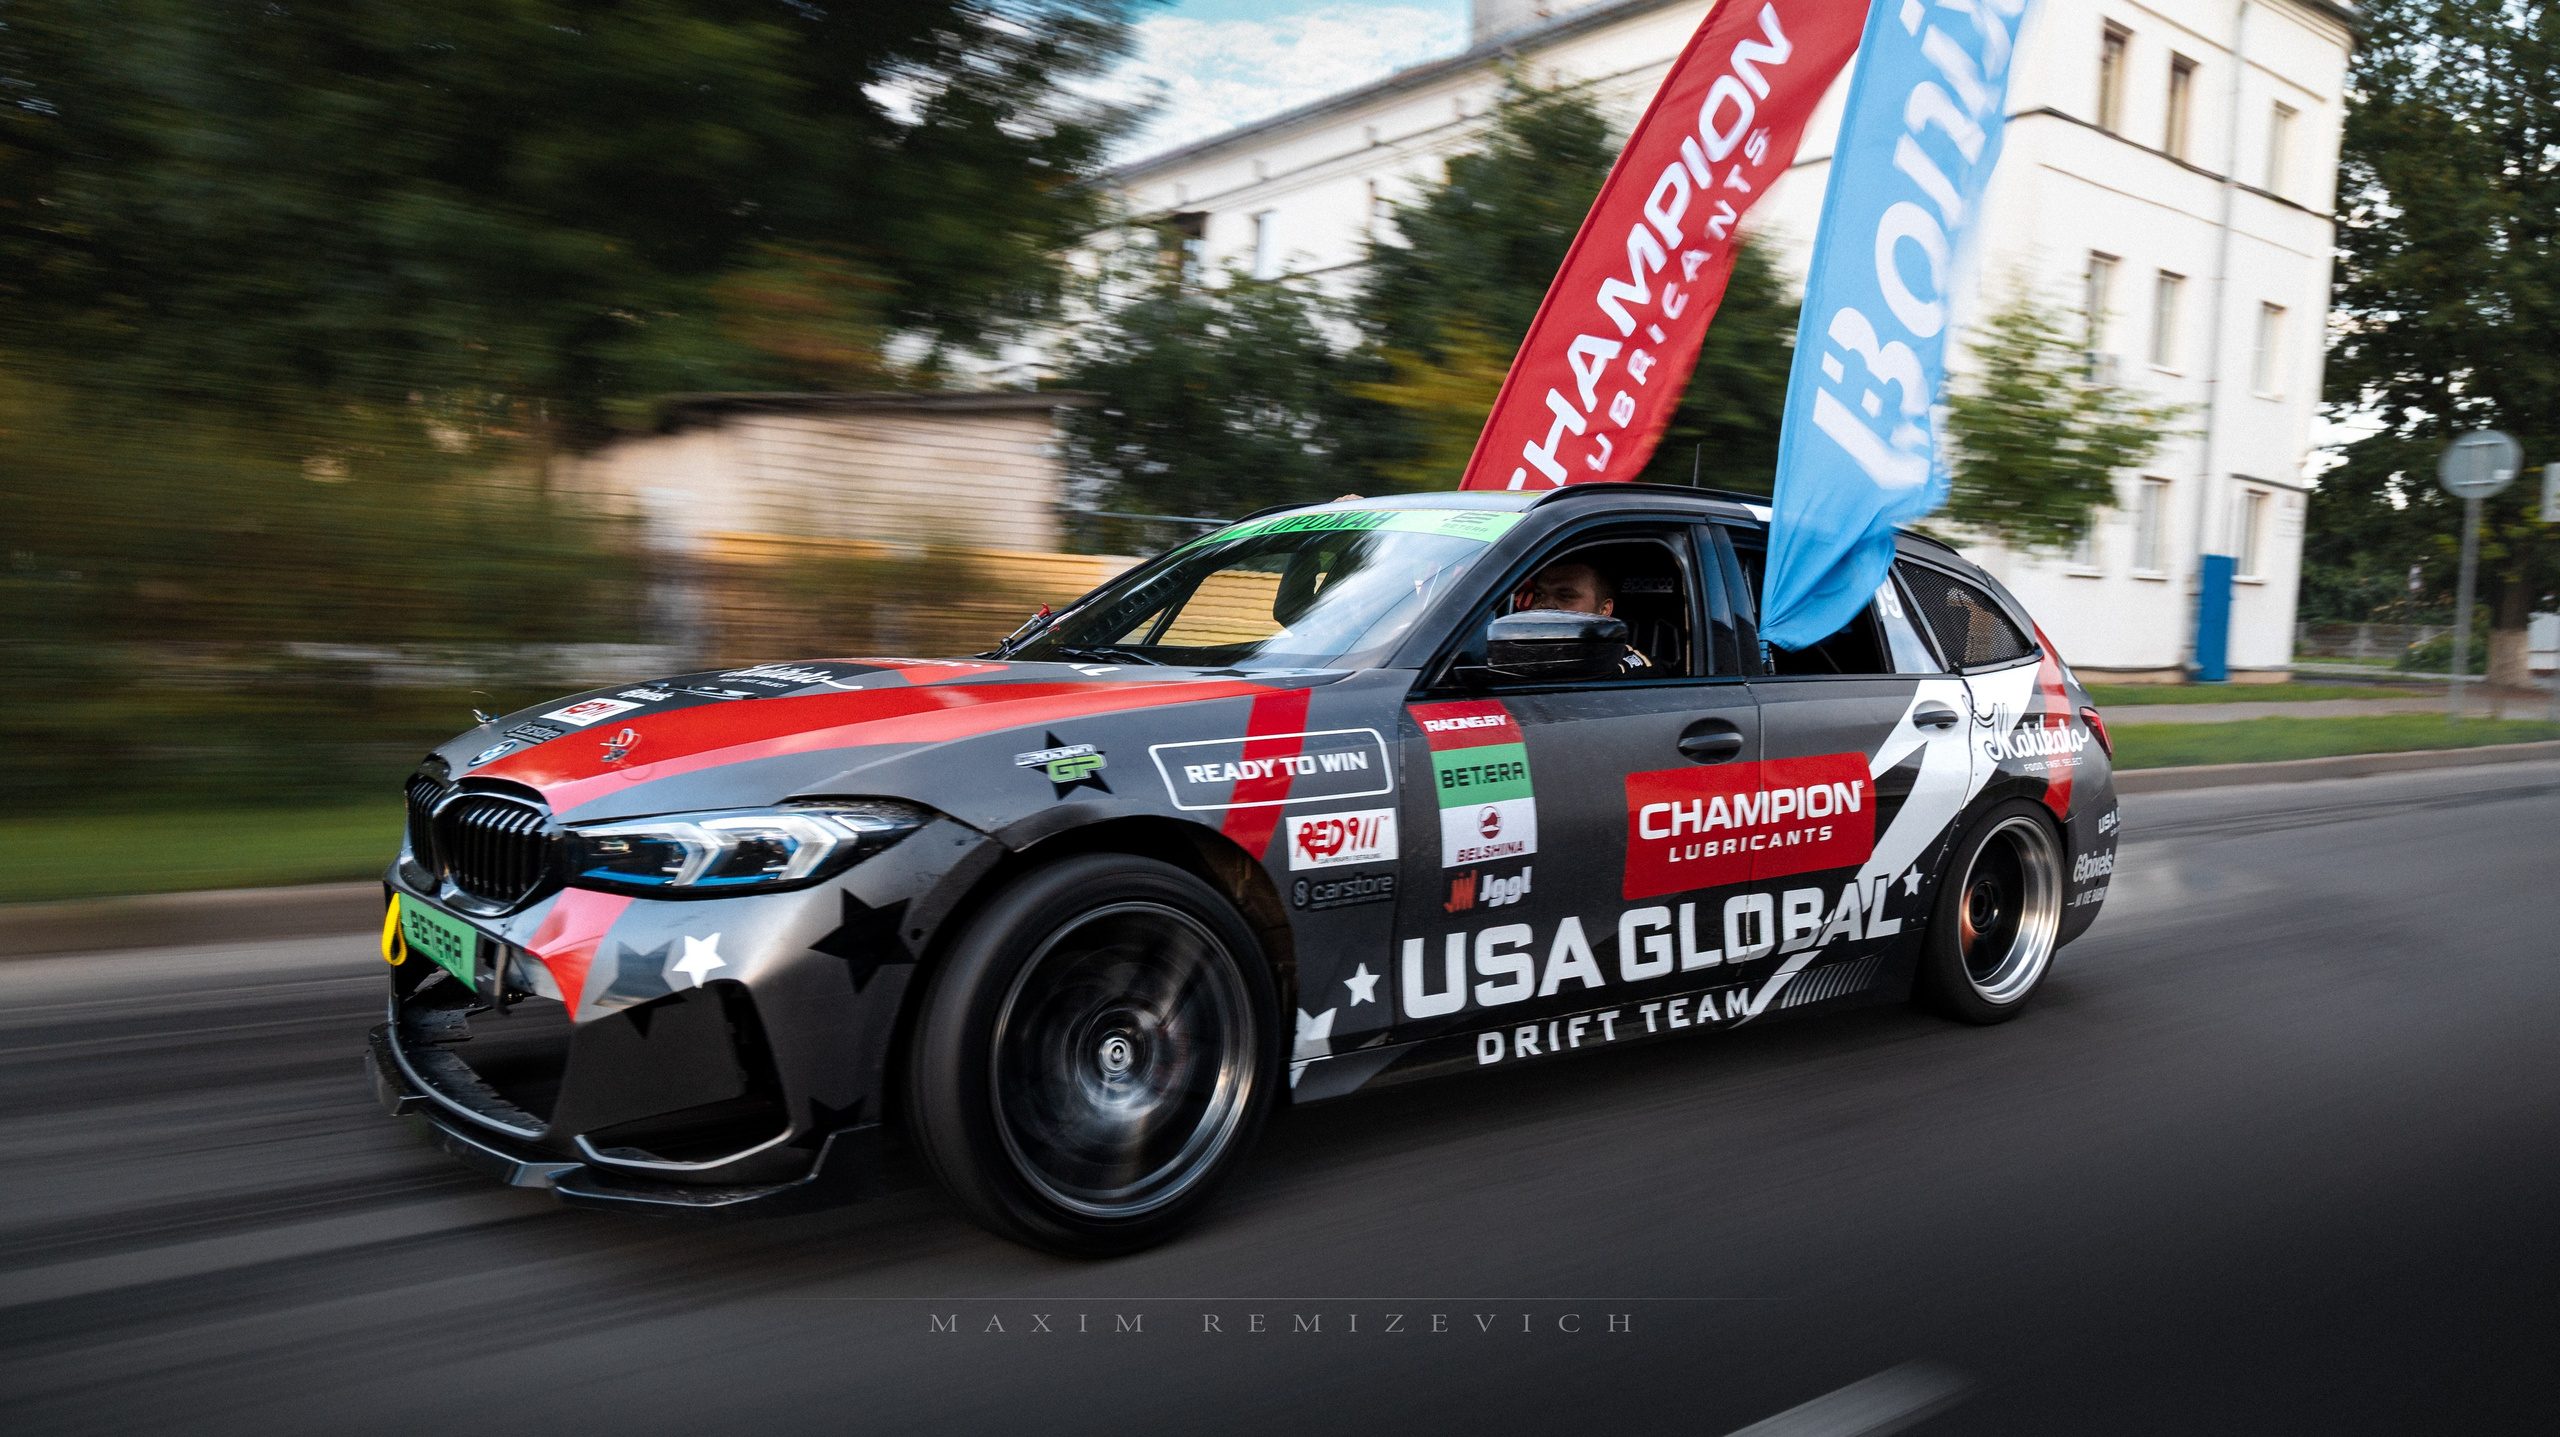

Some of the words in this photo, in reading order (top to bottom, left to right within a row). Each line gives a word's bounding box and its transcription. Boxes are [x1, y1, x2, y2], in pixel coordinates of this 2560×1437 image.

[1585, 126, 1771, 473] UBRICANTS
[1047, 754, 1107, 783] GP
[1183, 759, 1275, 783] READY
[1279, 755, 1318, 776] TO
[1318, 751, 1369, 773] WIN
[1638, 780, 1862, 840] CHAMPION
[1456, 840, 1525, 863] BELSHINA
[1668, 825, 1833, 863] LUBRICANTS
[1311, 875, 1394, 901] carstore
[1401, 916, 1607, 1019] USA
[1618, 875, 1903, 983] GLOBAL
[1476, 1009, 1622, 1066] DRIFT
[1639, 986, 1751, 1034] TEAM
